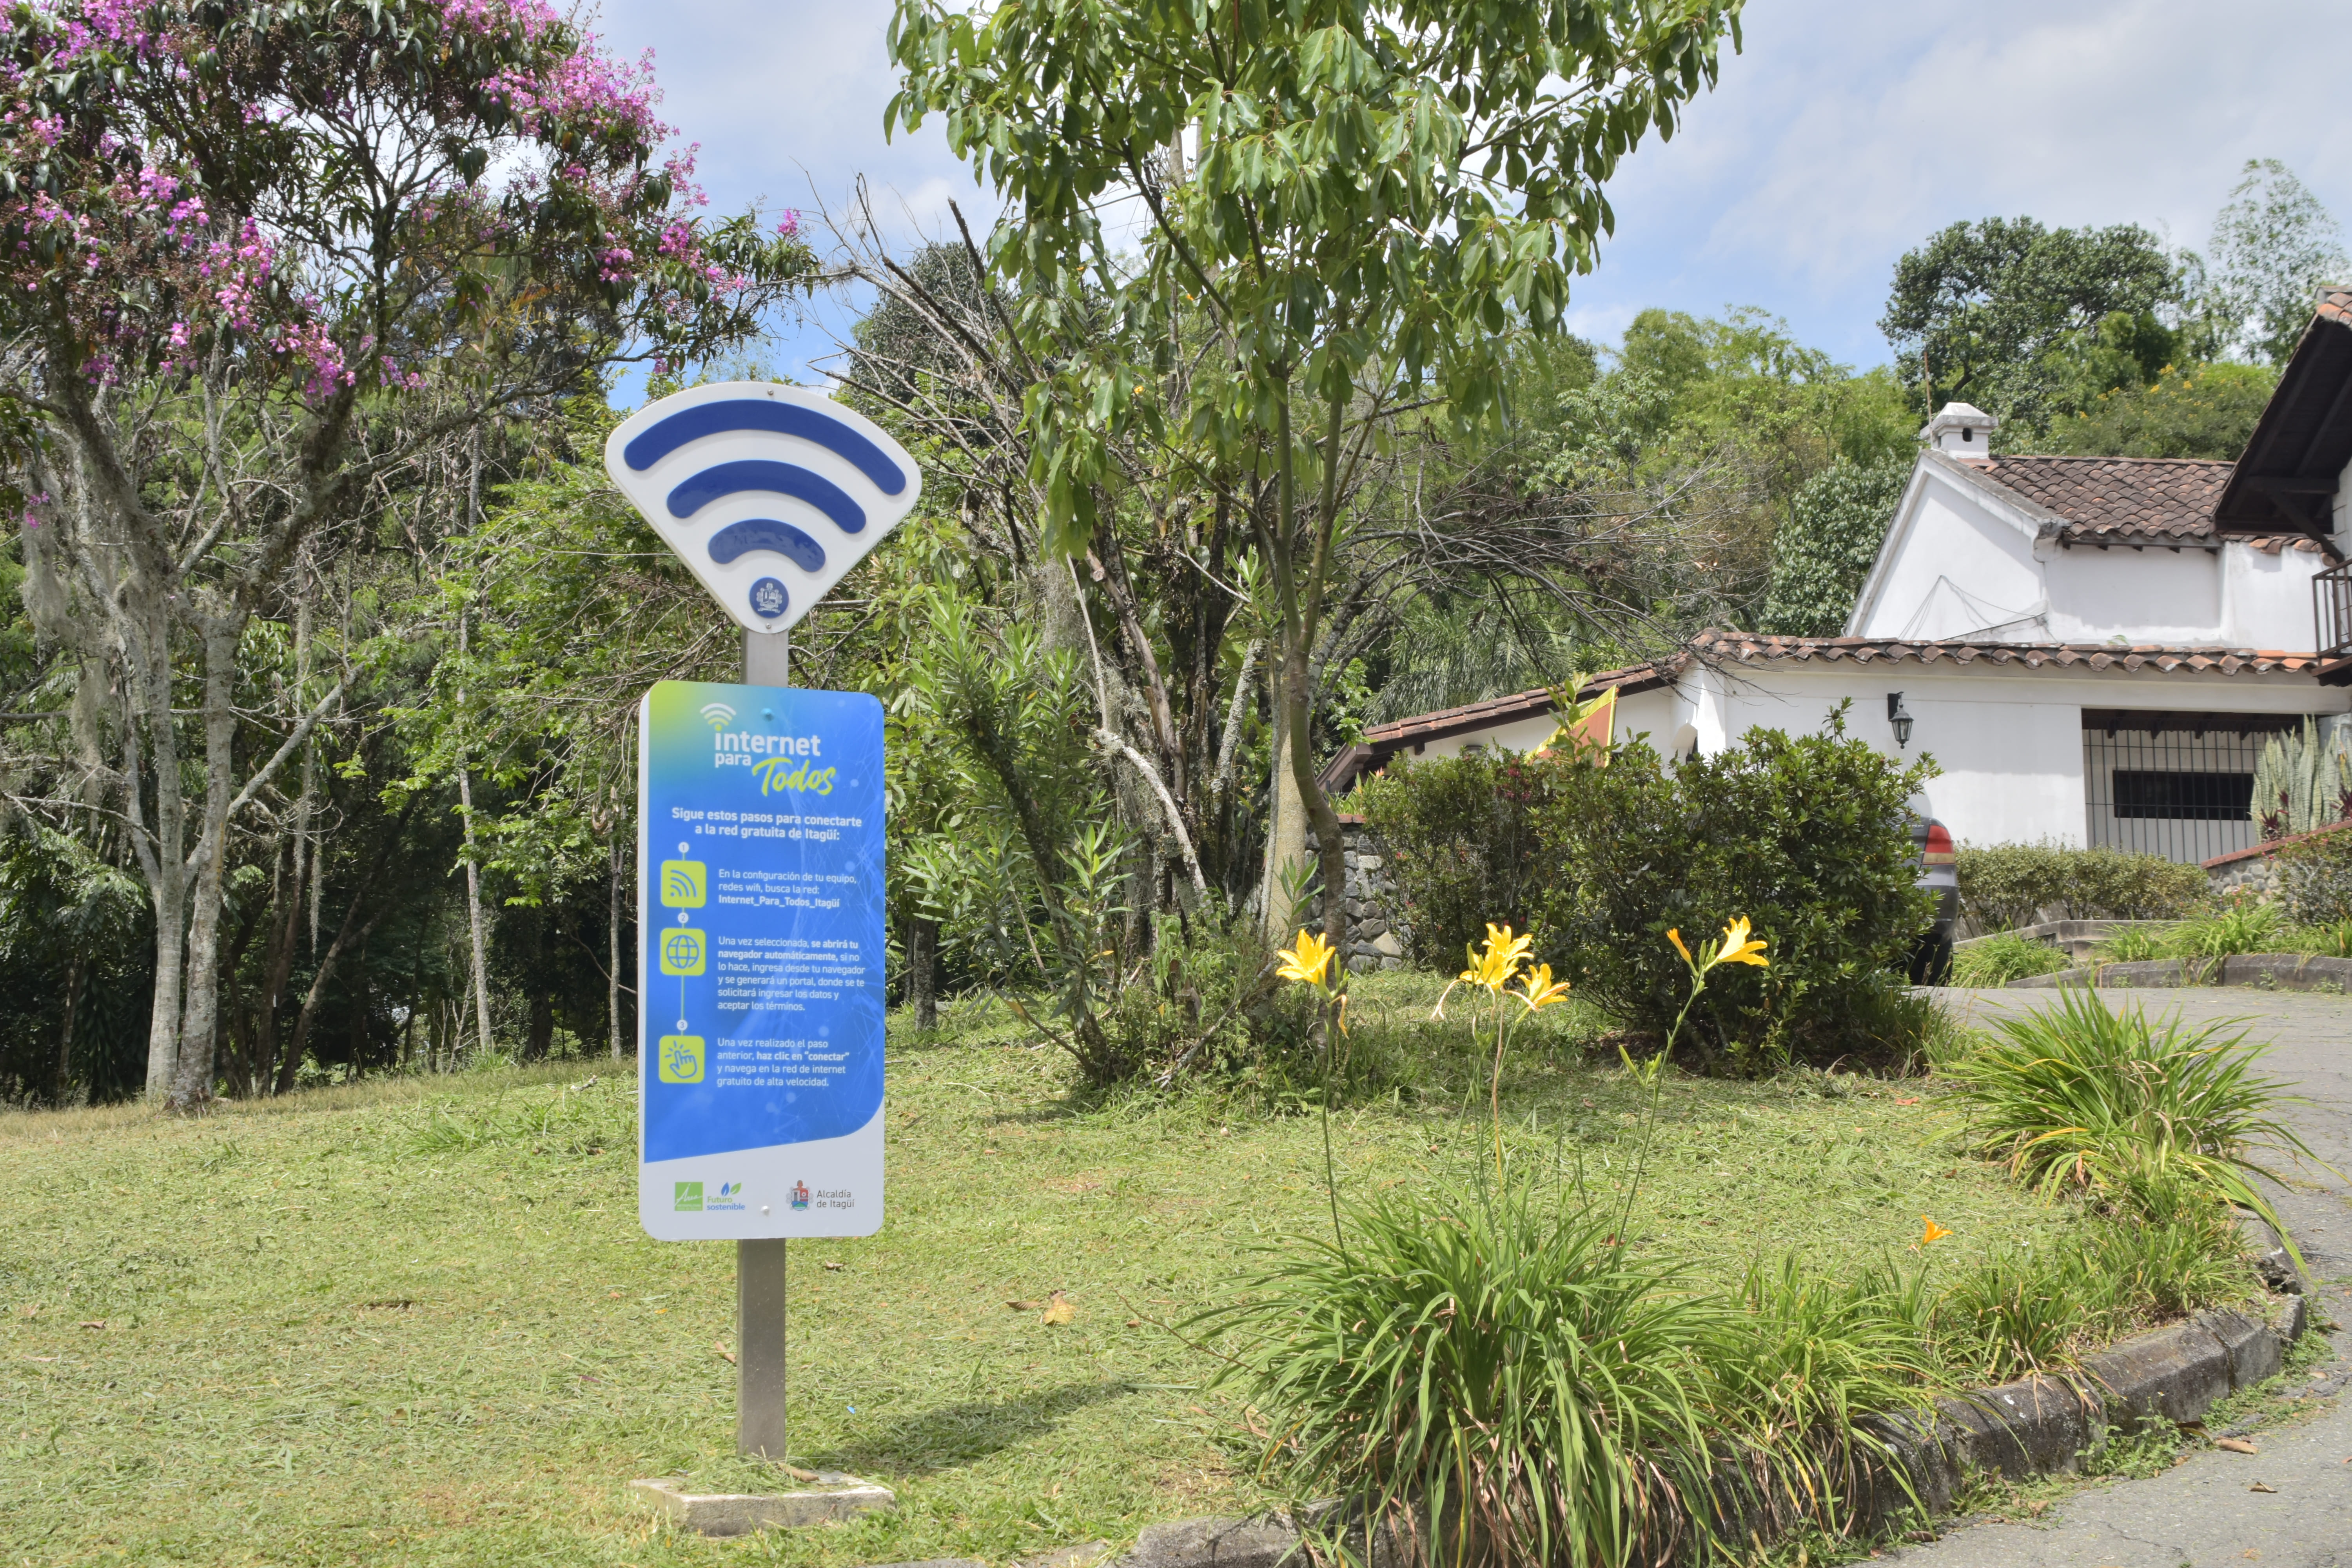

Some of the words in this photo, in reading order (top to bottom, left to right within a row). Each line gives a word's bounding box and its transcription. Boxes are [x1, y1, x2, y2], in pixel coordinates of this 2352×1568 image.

[715, 725, 821, 756] internet
[715, 752, 751, 768] para
[752, 757, 836, 797] Todos
[672, 808, 704, 821] Sigue
[708, 810, 737, 820] estos
[741, 813, 773, 824] pasos
[776, 815, 801, 825] para
[804, 815, 862, 827] conectarte
[706, 824, 715, 835] la
[719, 824, 738, 835] red
[741, 826, 785, 838] gratuita
[788, 827, 802, 838] de
[806, 828, 840, 842] Itagüí:
[719, 869, 730, 878] En
[733, 870, 740, 878] la
[743, 870, 800, 882] configuración
[803, 872, 813, 881] de
[815, 873, 824, 882] tu
[826, 874, 857, 884] equipo,
[719, 883, 743, 891] redes
[746, 884, 763, 893] wifi,
[766, 884, 790, 893] busca
[793, 884, 800, 893] la
[803, 885, 819, 894] red:
[719, 936, 735, 946] Una
[755, 938, 809, 948] seleccionada,
[823, 939, 847, 948] abrirá
[719, 950, 762, 960] navegador
[719, 963, 726, 971] lo
[728, 963, 750, 973] hace,
[752, 964, 783, 974] ingresa
[785, 964, 809, 973] desde
[822, 965, 865, 975] navegador
[737, 975, 774, 986] generará
[790, 976, 815, 987] portal,
[818, 978, 842, 986] donde
[718, 988, 755, 997] solicitará
[759, 989, 793, 1000] ingresar
[795, 989, 808, 998] los
[809, 990, 832, 998] datos
[834, 991, 839, 1000] y
[718, 1002, 750, 1011] aceptar
[752, 1001, 764, 1010] los
[766, 1001, 805, 1011] términos.
[718, 1038, 735, 1047] Una
[756, 1039, 795, 1048] realizado
[798, 1040, 805, 1048] el
[808, 1041, 828, 1050] paso
[718, 1051, 754, 1061] anterior,
[757, 1051, 772, 1060] haz
[774, 1051, 789, 1060] clic
[725, 1065, 756, 1074] navega
[772, 1065, 779, 1073] la
[782, 1065, 797, 1073] red
[800, 1065, 809, 1073] de
[813, 1065, 846, 1074] internet
[717, 1078, 751, 1087] gratuito
[754, 1077, 764, 1085] de
[767, 1077, 783, 1086] alta
[786, 1078, 828, 1086] velocidad.
[817, 1189, 851, 1198] Alcaldía
[830, 1199, 854, 1209] Itagüí
